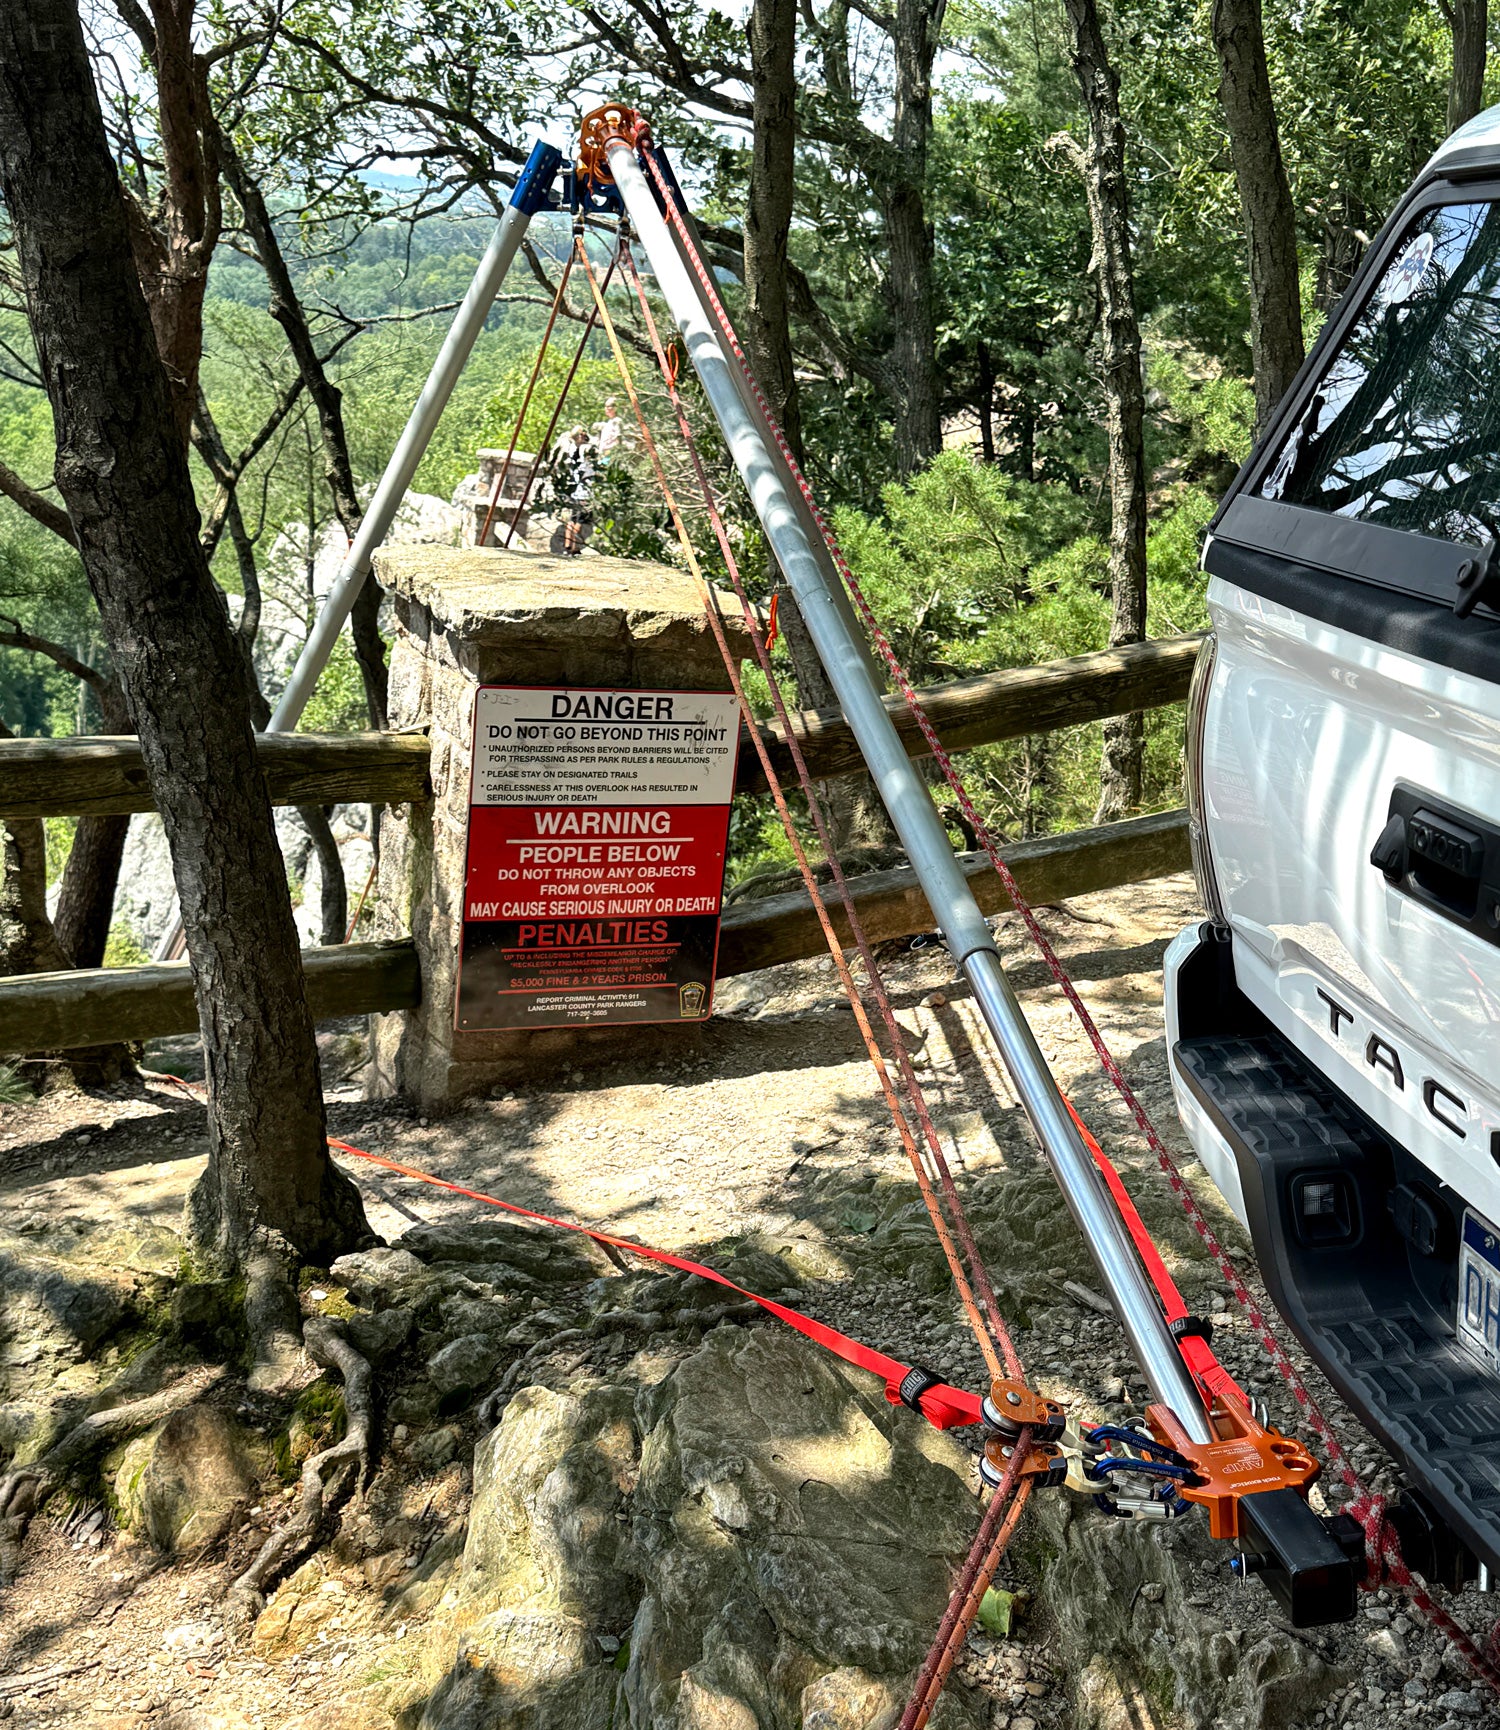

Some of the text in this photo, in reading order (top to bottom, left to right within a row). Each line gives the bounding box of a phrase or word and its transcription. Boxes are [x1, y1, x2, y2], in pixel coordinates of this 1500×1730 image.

[552, 695, 673, 719] DANGER
[489, 726, 727, 741] DO NOT GO BEYOND THIS POINT
[489, 745, 553, 753] UNAUTHORIZED
[597, 746, 630, 754] BEYOND
[489, 755, 506, 763] FOR
[567, 756, 578, 764] AS
[598, 756, 619, 764] PARK
[622, 756, 647, 764] RULES
[558, 771, 608, 779] DESIGNATED
[611, 771, 638, 779] TRAILS
[487, 784, 551, 792] CARELESSNESS
[553, 784, 563, 792] AT
[566, 784, 583, 792] THIS
[649, 784, 688, 792] RESULTED
[487, 794, 523, 802] SERIOUS
[525, 794, 554, 802] INJURY
[534, 811, 671, 835] WARNING
[1410, 820, 1466, 872] TOYOTA
[520, 845, 680, 864] PEOPLE BELOW
[498, 866, 696, 880] DO NOT THROW ANY OBJECTS
[540, 883, 655, 895] FROM OVERLOOK
[471, 897, 715, 918] MAY CAUSE SERIOUS INJURY OR DEATH
[518, 921, 668, 947] PENALTIES
[510, 973, 667, 987] $5,000 FINE & 2 YEARS PRISON
[1316, 985, 1500, 1168] TAC
[1222, 1458, 1264, 1474] AHP
